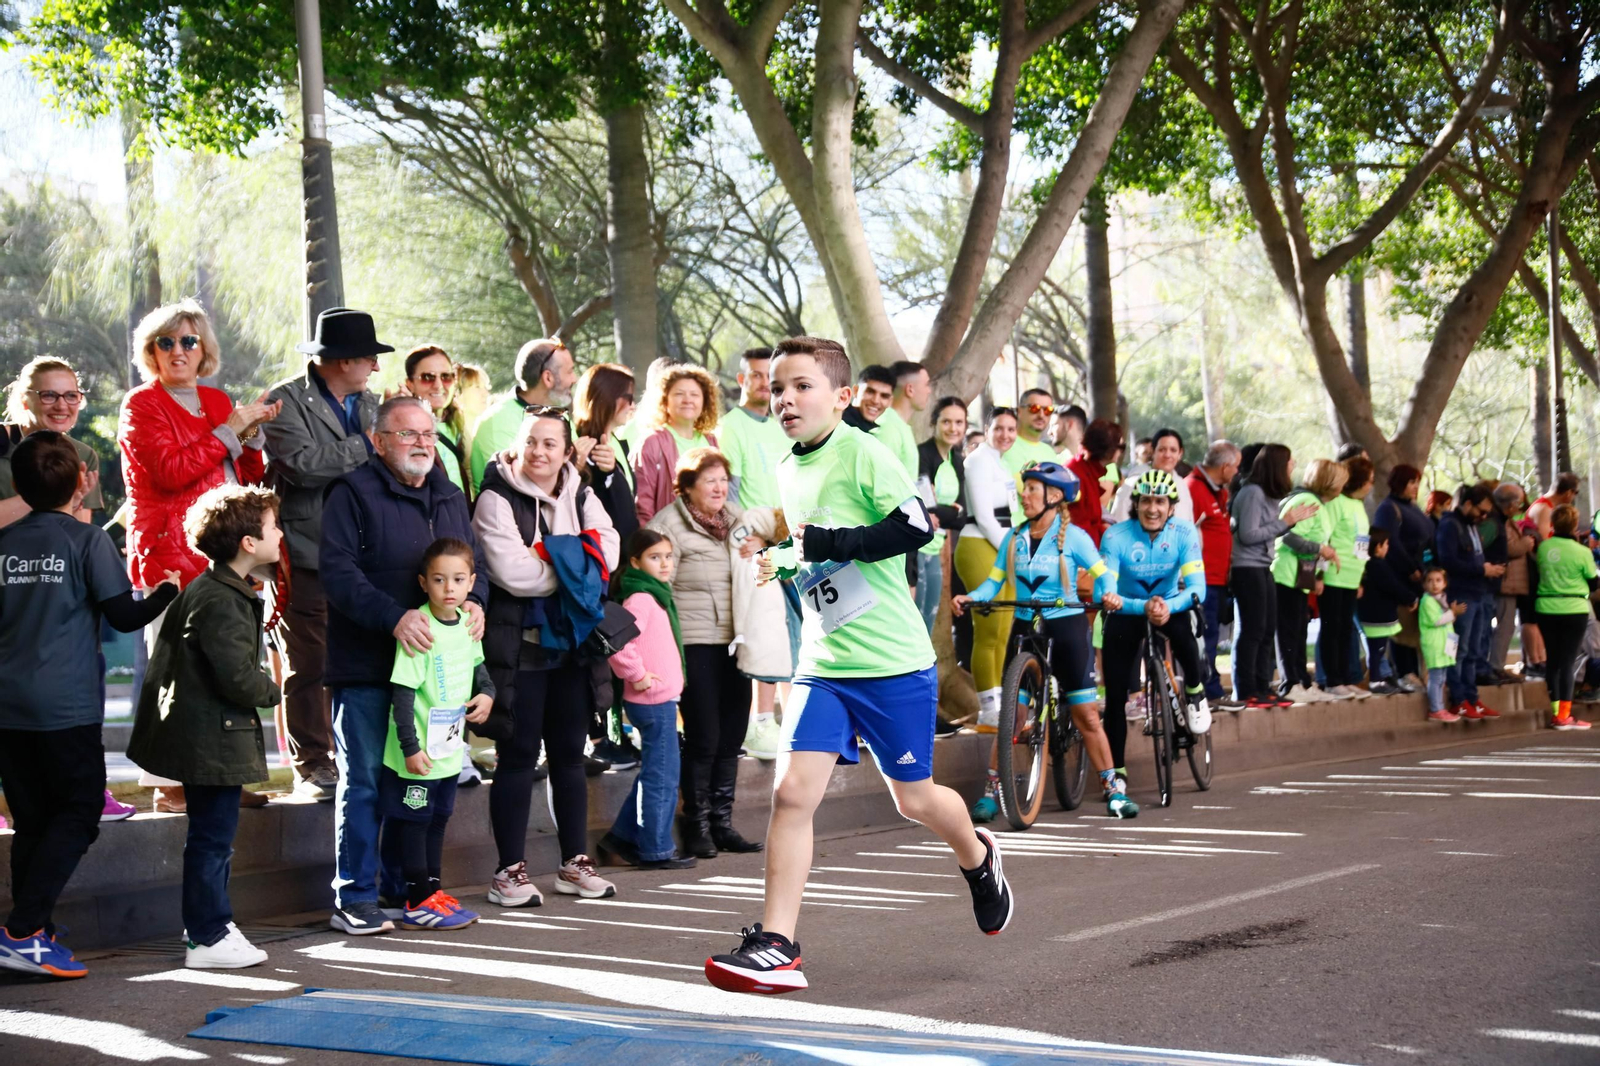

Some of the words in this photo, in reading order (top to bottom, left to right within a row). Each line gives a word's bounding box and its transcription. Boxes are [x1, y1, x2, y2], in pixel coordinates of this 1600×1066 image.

[40, 574, 63, 584] TEAM
[807, 578, 839, 612] 75
[433, 654, 447, 702] ALMERÍA
[445, 720, 460, 742] 24
